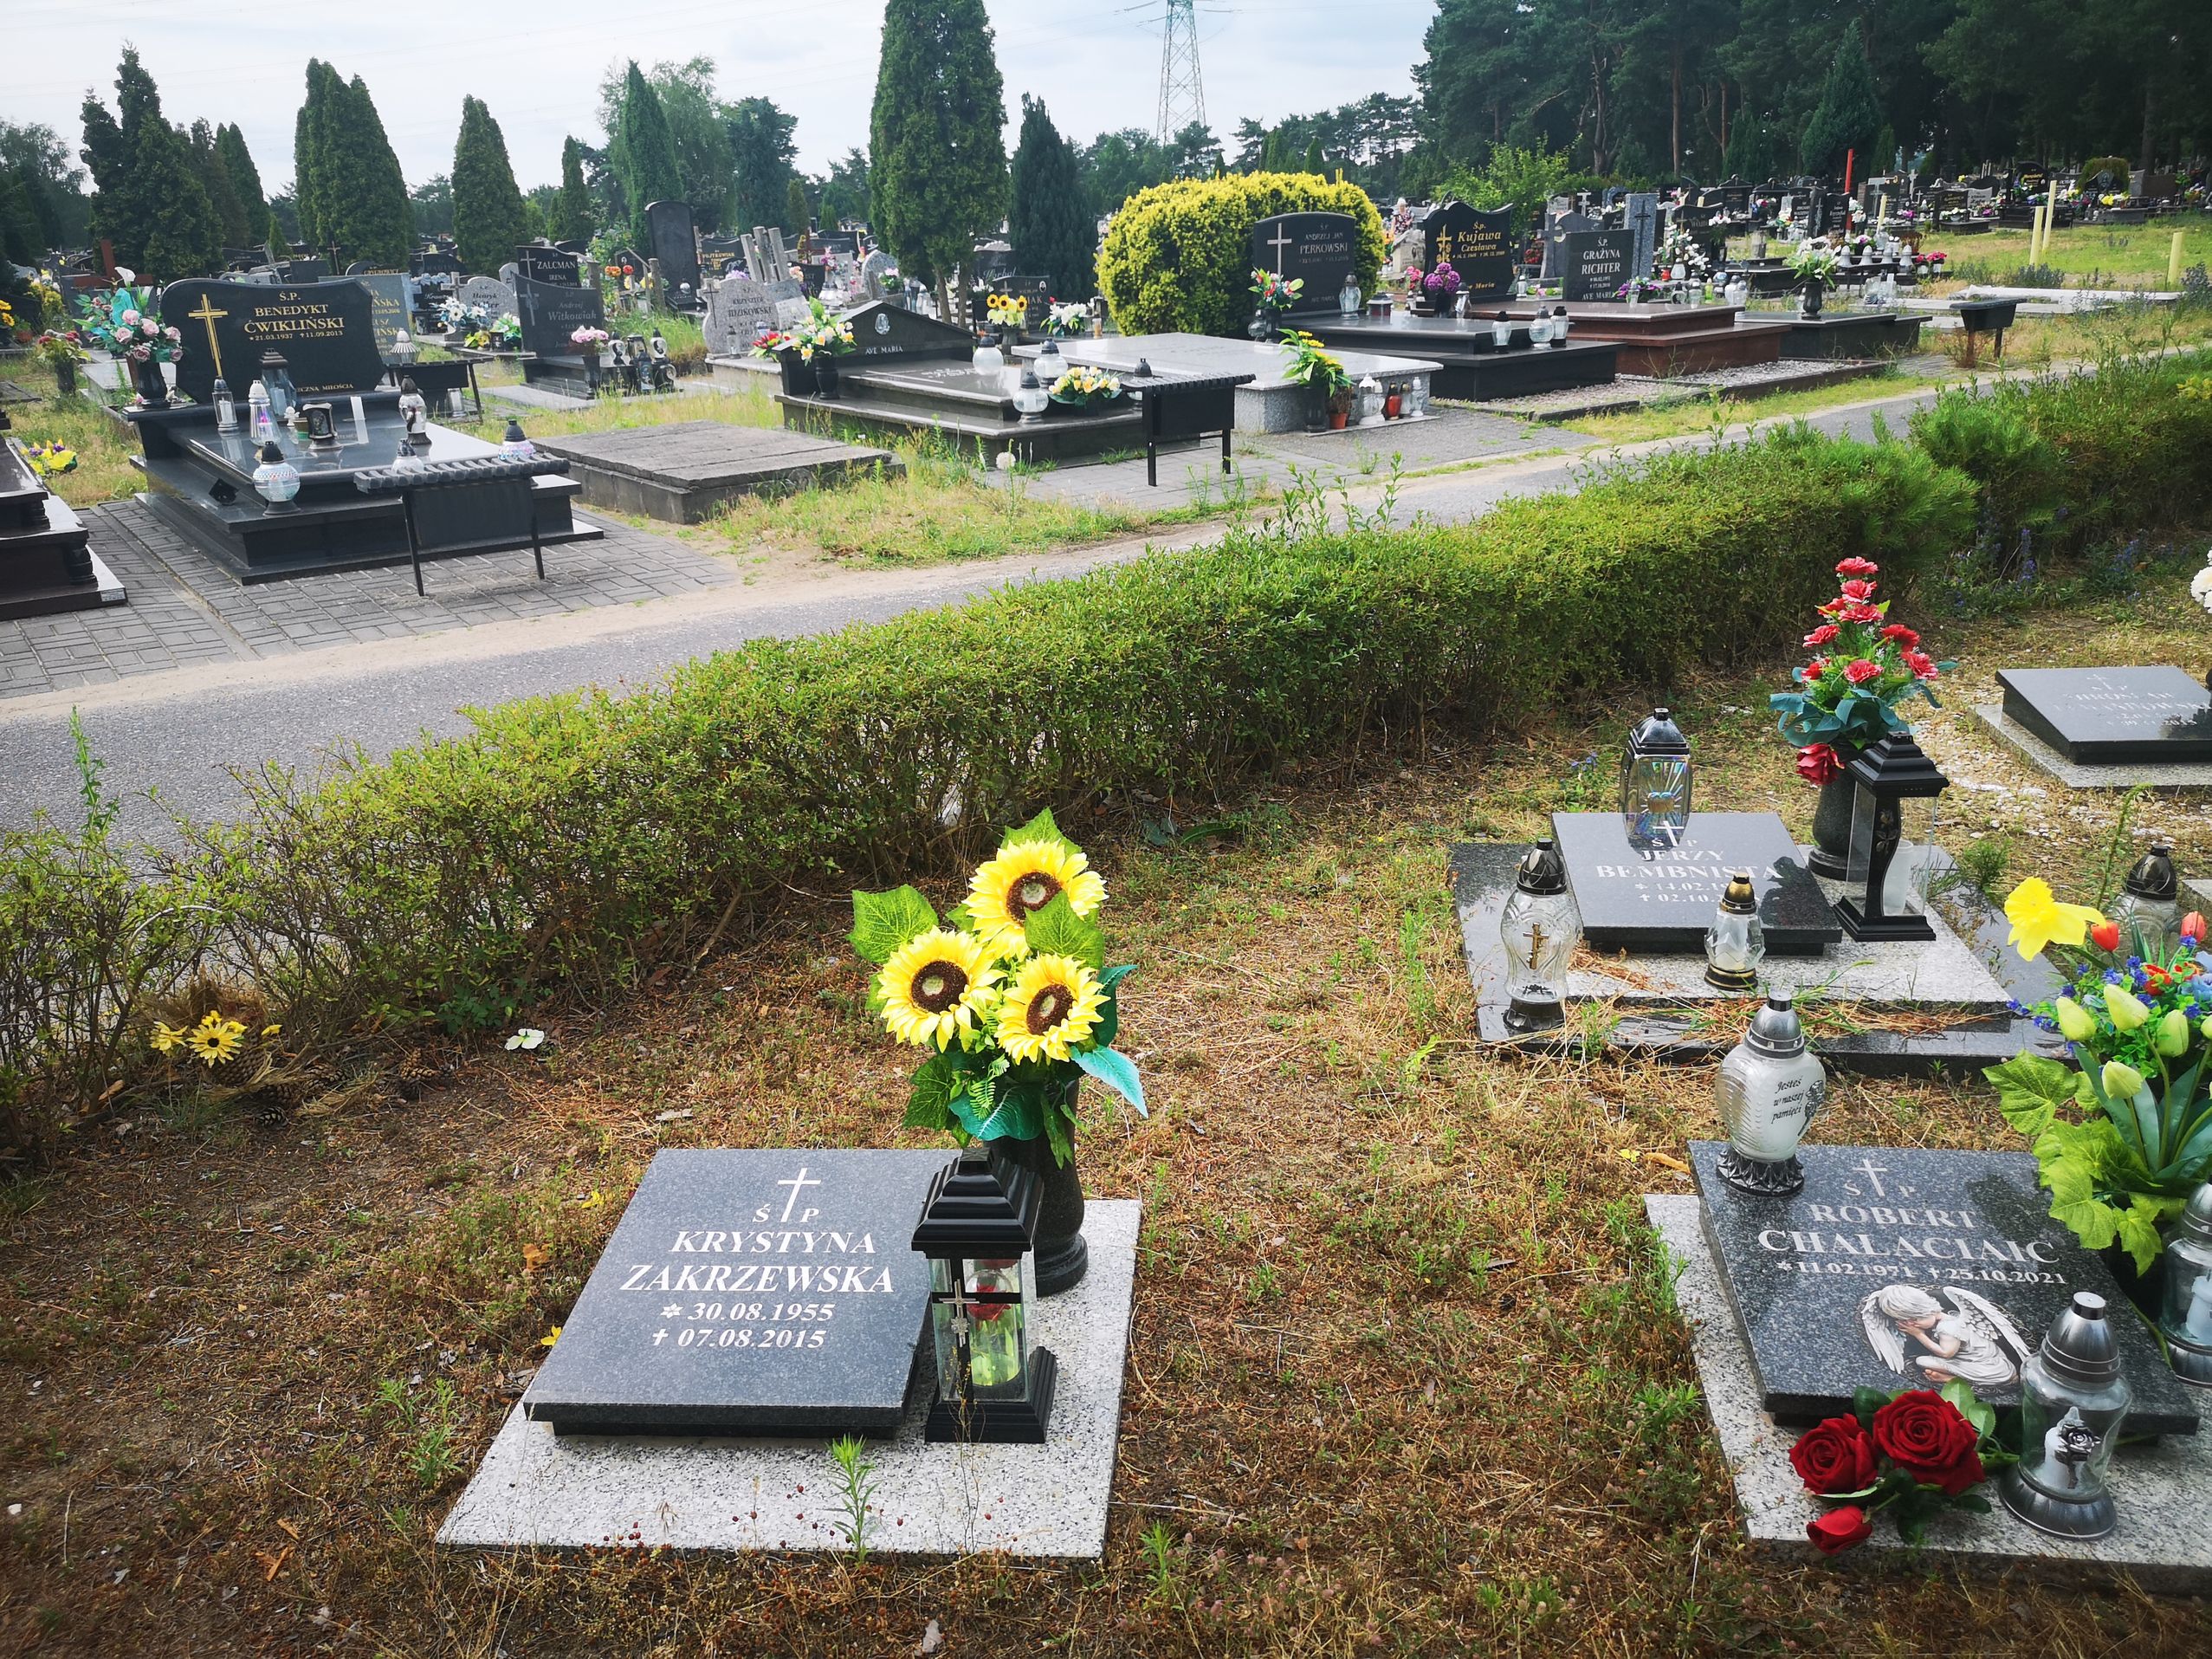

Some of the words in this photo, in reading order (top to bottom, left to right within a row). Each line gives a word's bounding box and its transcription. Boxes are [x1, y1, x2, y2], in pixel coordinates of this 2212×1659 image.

[1458, 230, 1501, 243] Kujawa
[1299, 243, 1348, 255] PERKOWSKI
[1461, 243, 1497, 252] Czesława
[1583, 248, 1620, 260] GRAŻYNA
[537, 261, 576, 269] ZALCMAN
[1581, 262, 1620, 275] RICHTER
[255, 304, 328, 317] BENEDYKT
[548, 309, 597, 321] Witkowiak
[243, 316, 345, 333] ĆWIKLIŃSKI
[1640, 850, 1724, 862] JERZY
[1655, 882, 1728, 891] 14.02.19
[1658, 893, 1721, 903] 02.10.
[1775, 1075, 1803, 1094] Jesteś
[1782, 1090, 1804, 1104] naszej
[1771, 1104, 1802, 1124] pamięci
[1898, 1185, 1915, 1197] P
[752, 1203, 771, 1222] Ś
[799, 1208, 819, 1222] P
[1808, 1203, 1976, 1229] ROBERT
[668, 1230, 876, 1254] KRYSTYNA
[1757, 1229, 2060, 1264] CHALACIAIC
[618, 1264, 895, 1293] ZAKRZEWSKA
[1945, 1267, 2069, 1285] 25.10.2021
[687, 1302, 836, 1322] 30.08.1955
[676, 1328, 828, 1349] 07.08.2015
